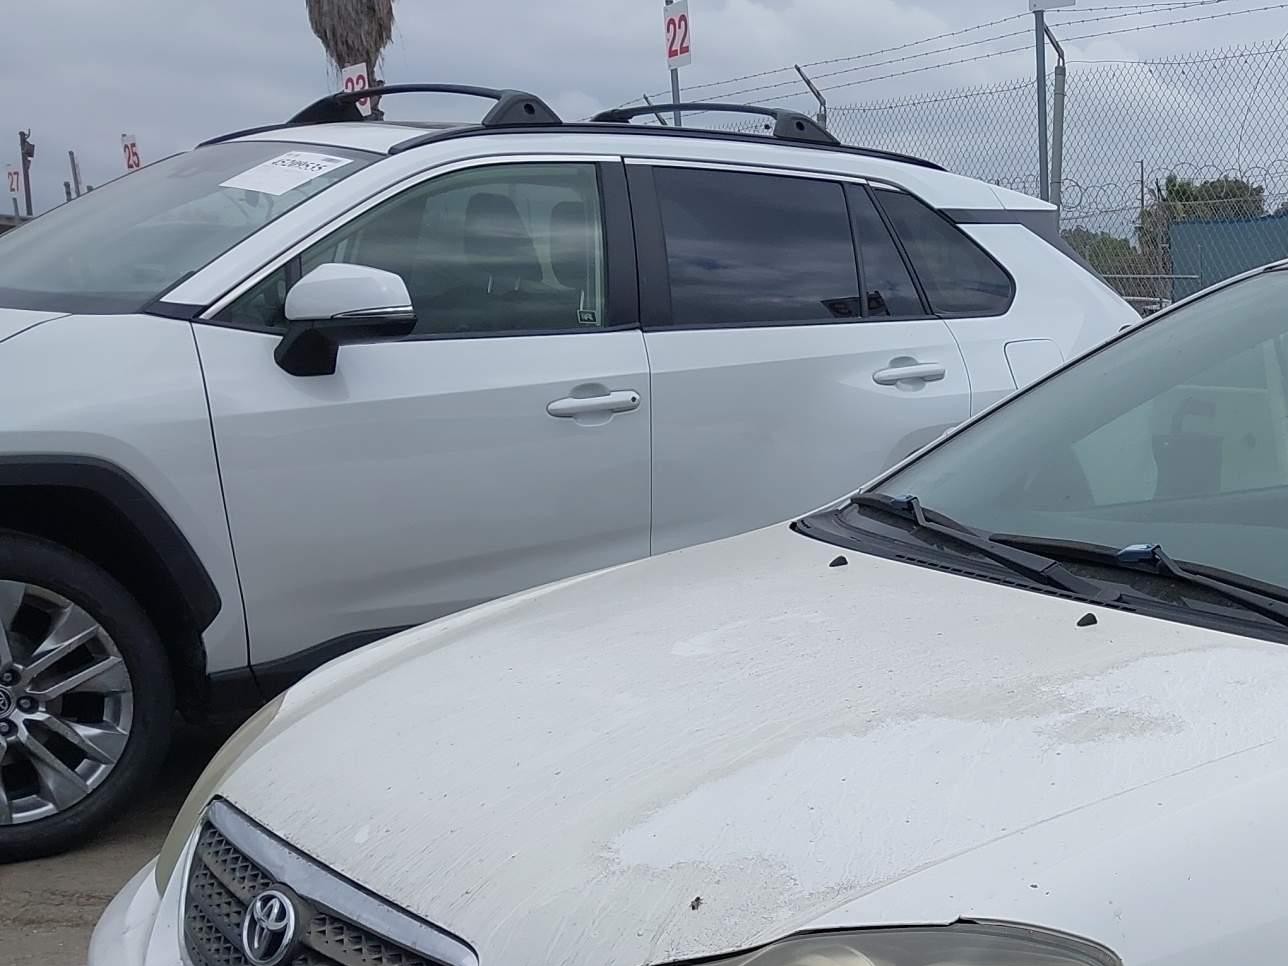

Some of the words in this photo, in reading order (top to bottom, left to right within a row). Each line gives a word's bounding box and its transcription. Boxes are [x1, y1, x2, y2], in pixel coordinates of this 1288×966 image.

[667, 14, 689, 58] 22
[123, 142, 140, 169] 25
[8, 171, 20, 192] 27
